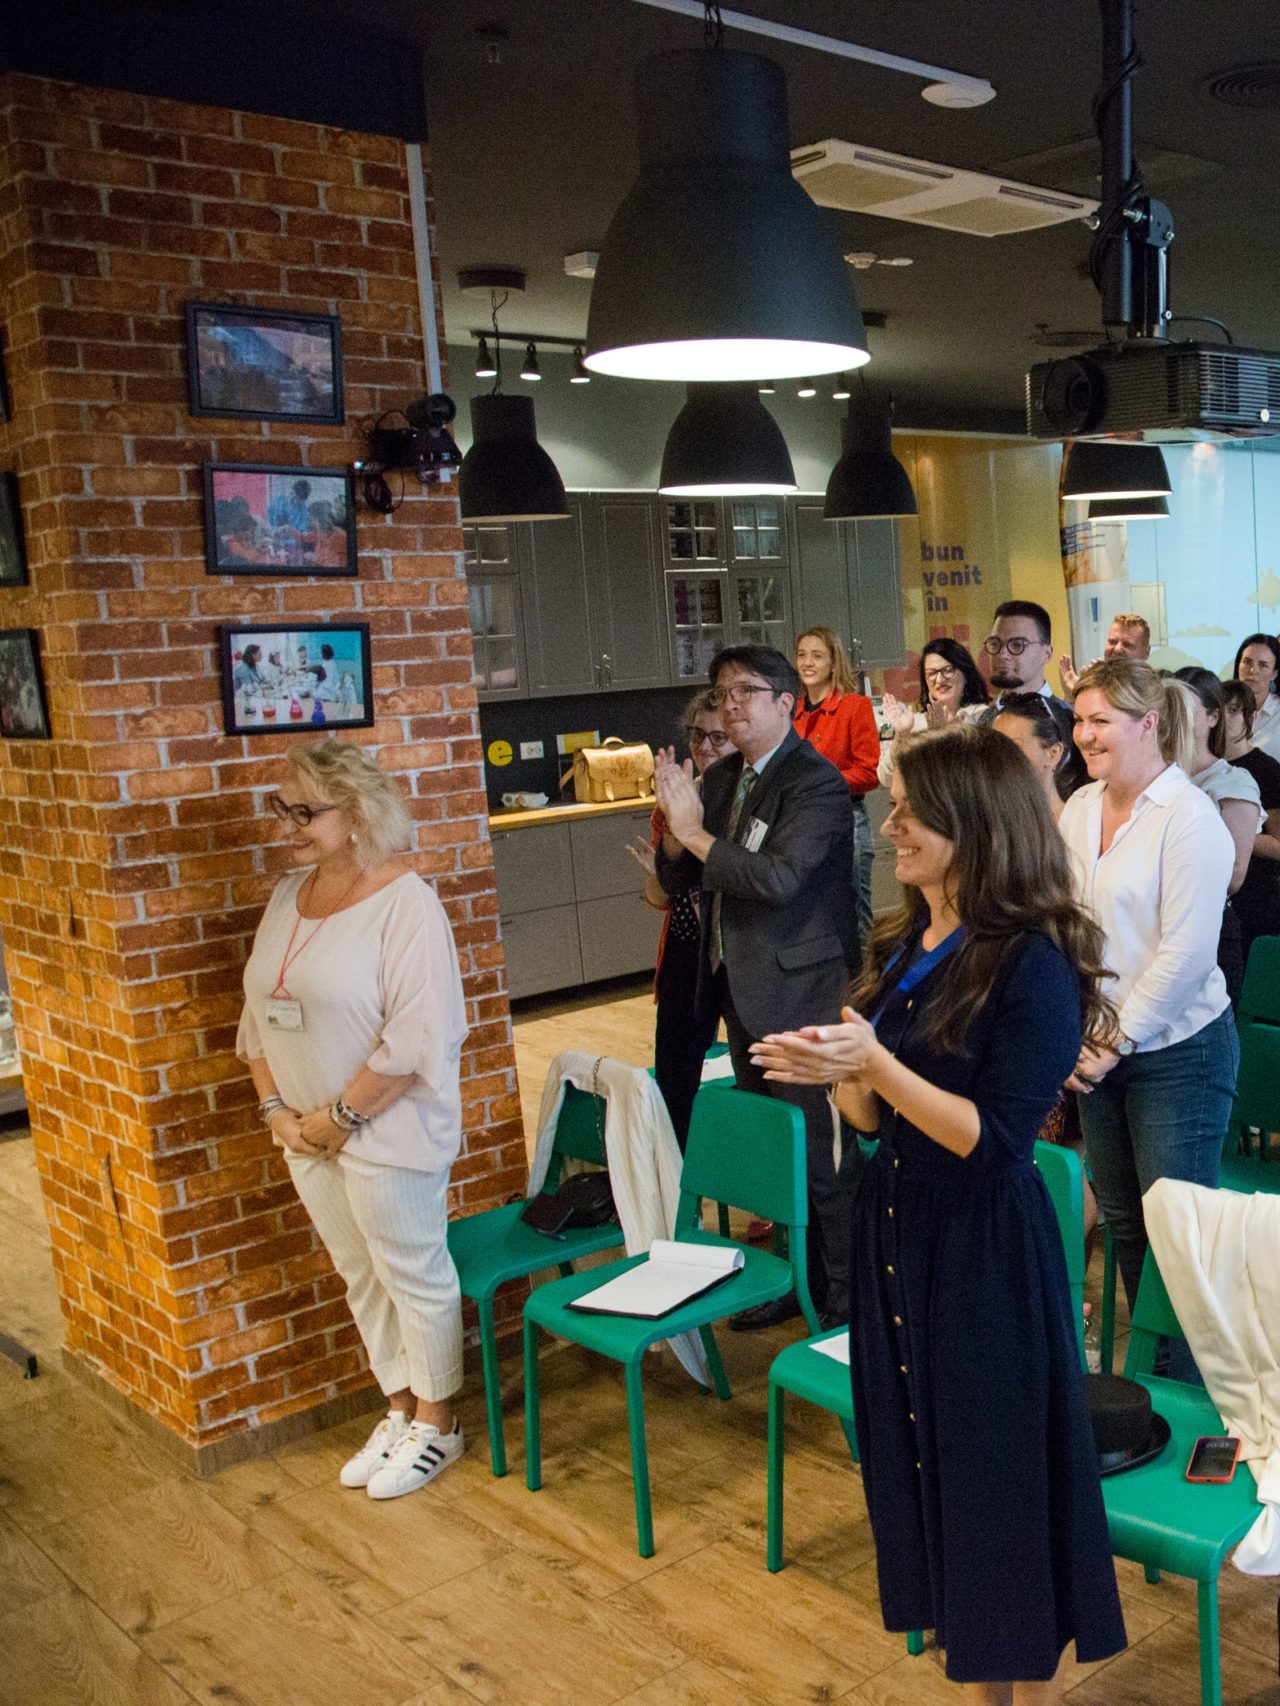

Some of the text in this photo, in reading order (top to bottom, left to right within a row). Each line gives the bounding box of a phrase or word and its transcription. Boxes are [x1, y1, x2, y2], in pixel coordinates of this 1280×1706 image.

[921, 541, 964, 561] bun
[923, 564, 983, 587] venit
[926, 591, 948, 612] în
